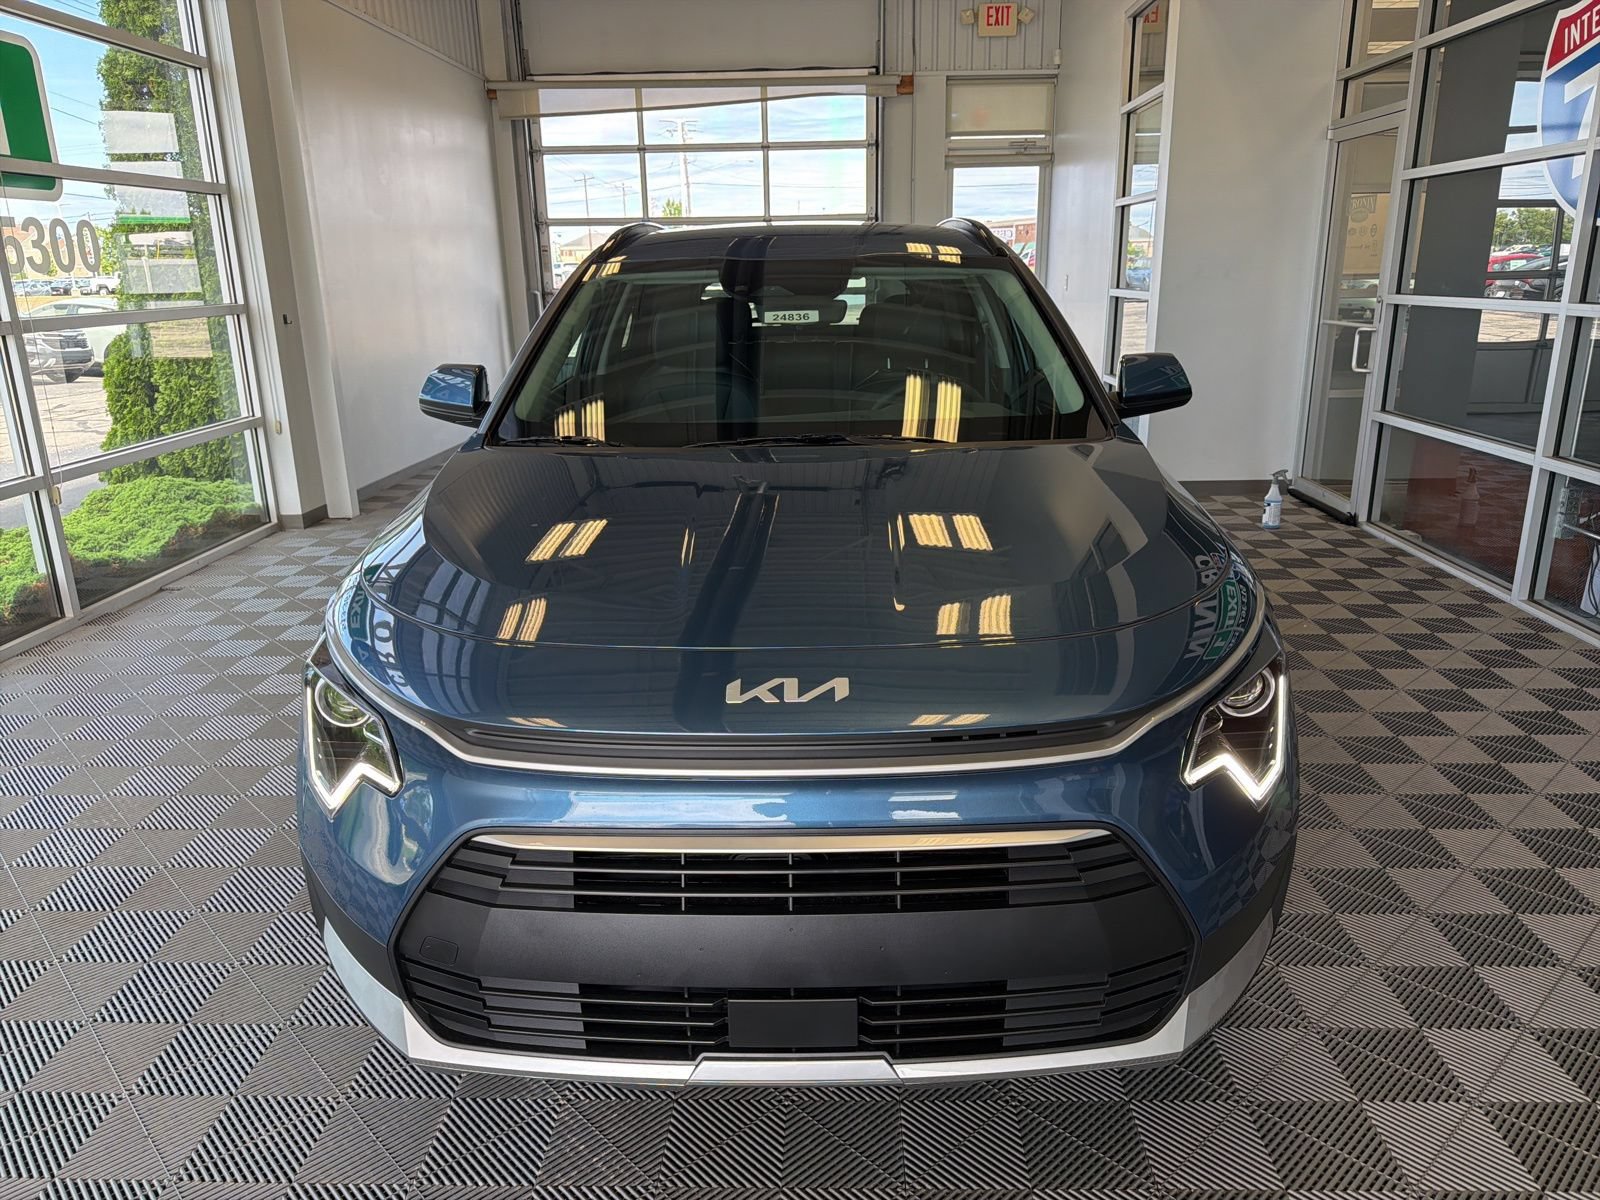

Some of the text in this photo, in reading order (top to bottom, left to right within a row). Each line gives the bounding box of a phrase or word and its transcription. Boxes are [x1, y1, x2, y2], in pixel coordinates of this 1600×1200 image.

[986, 5, 1012, 26] EXIT
[772, 313, 811, 322] 24836
[726, 677, 850, 704] KIA
